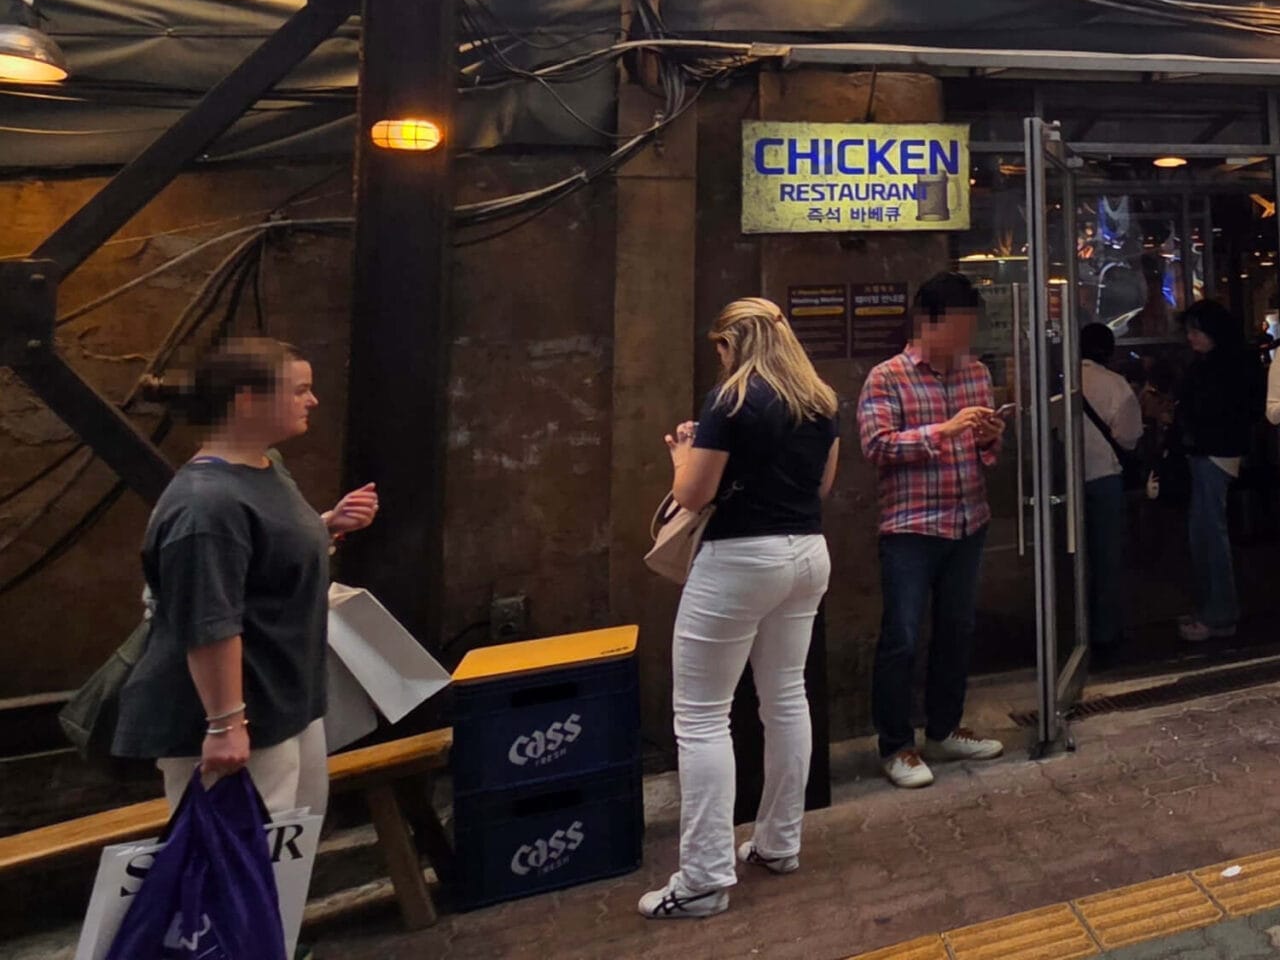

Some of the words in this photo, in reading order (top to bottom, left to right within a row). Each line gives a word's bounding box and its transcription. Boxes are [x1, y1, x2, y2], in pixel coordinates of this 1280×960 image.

[754, 137, 960, 175] CHICKEN
[780, 183, 927, 201] RESTAURANT
[807, 206, 841, 223] 즉석
[850, 206, 902, 223] 바베큐
